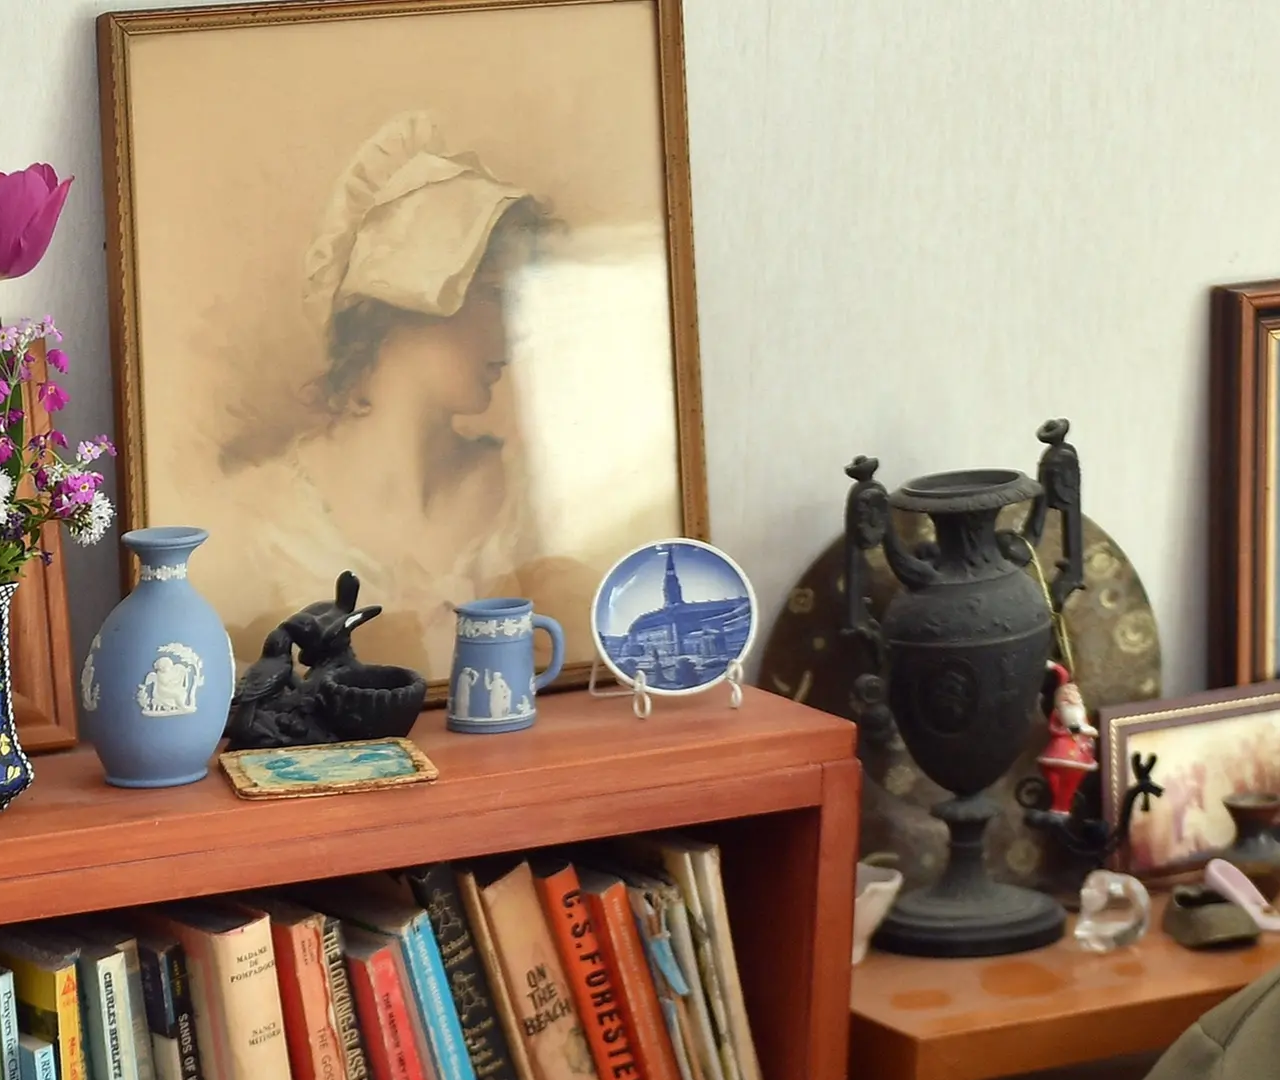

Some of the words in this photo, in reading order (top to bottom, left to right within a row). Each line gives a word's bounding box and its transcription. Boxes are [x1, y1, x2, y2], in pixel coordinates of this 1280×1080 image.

[526, 963, 548, 991] ON
[0, 989, 13, 1037] Prayers
[103, 971, 117, 1027] CHARLES
[526, 983, 558, 1013] THE
[178, 1012, 192, 1053] SANDS
[522, 1000, 572, 1038] BEACH
[5, 1037, 17, 1057] for
[109, 1028, 123, 1080] BERLITZ
[317, 1028, 329, 1051] THE
[184, 1056, 196, 1074] OF
